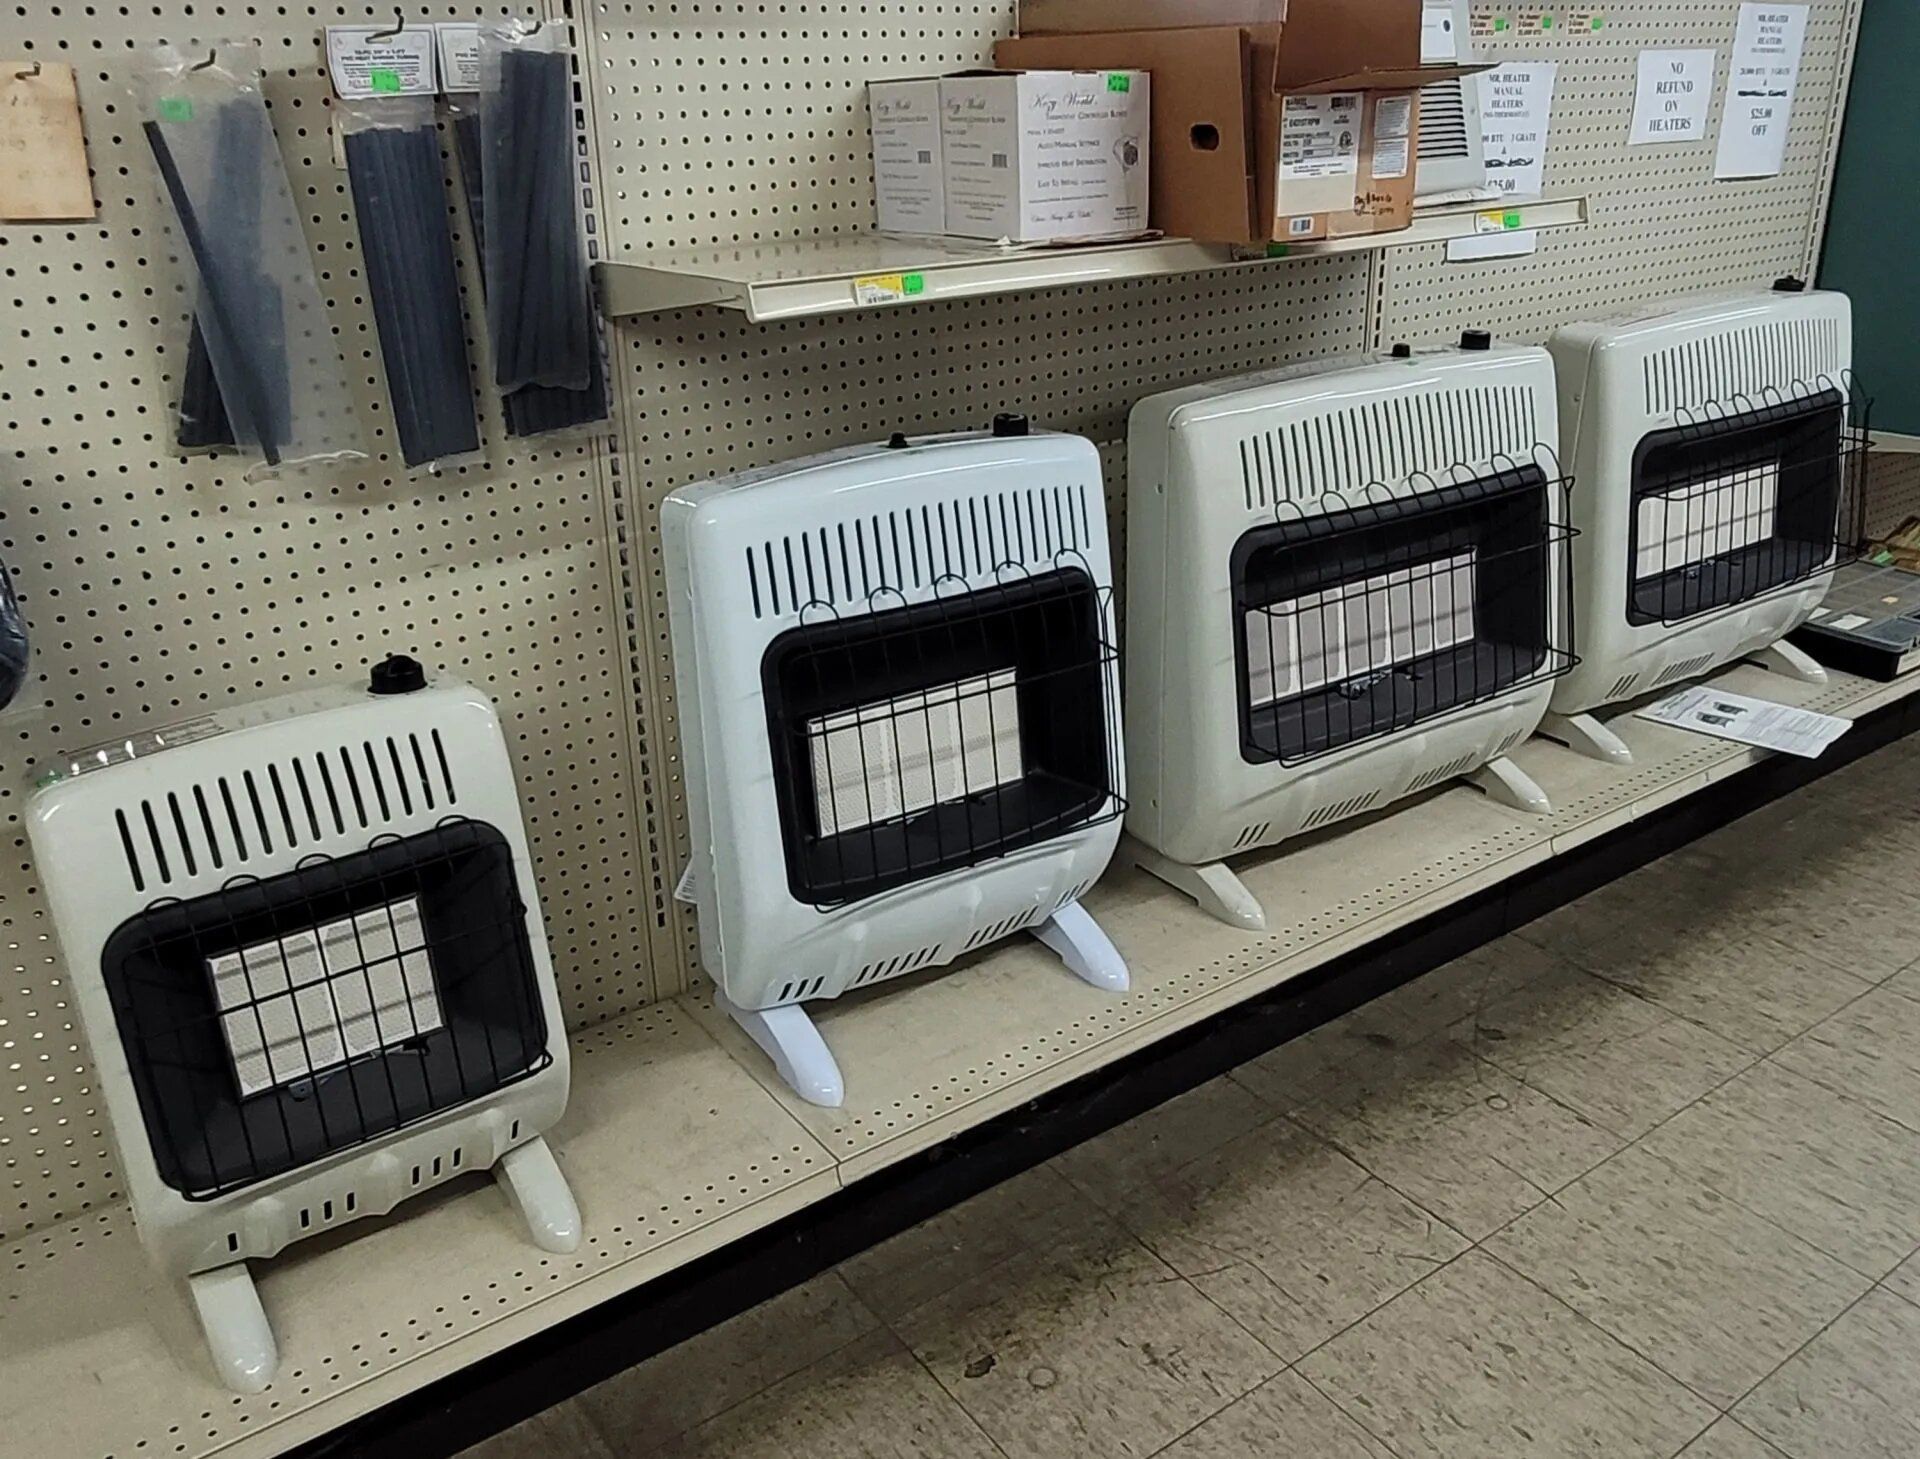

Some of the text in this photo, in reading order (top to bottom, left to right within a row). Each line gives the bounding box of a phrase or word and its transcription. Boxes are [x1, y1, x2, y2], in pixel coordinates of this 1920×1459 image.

[1671, 62, 1684, 74] NO
[1502, 73, 1531, 82] HEATER
[1494, 86, 1523, 95] MANUAL
[1656, 80, 1693, 94] REFUND
[1491, 100, 1524, 109] HEATERS
[1665, 100, 1678, 112] ON
[1649, 118, 1691, 132] HEATERS
[1751, 124, 1768, 136] OFF
[1491, 134, 1504, 142] BTU
[1515, 132, 1536, 142] GRATE
